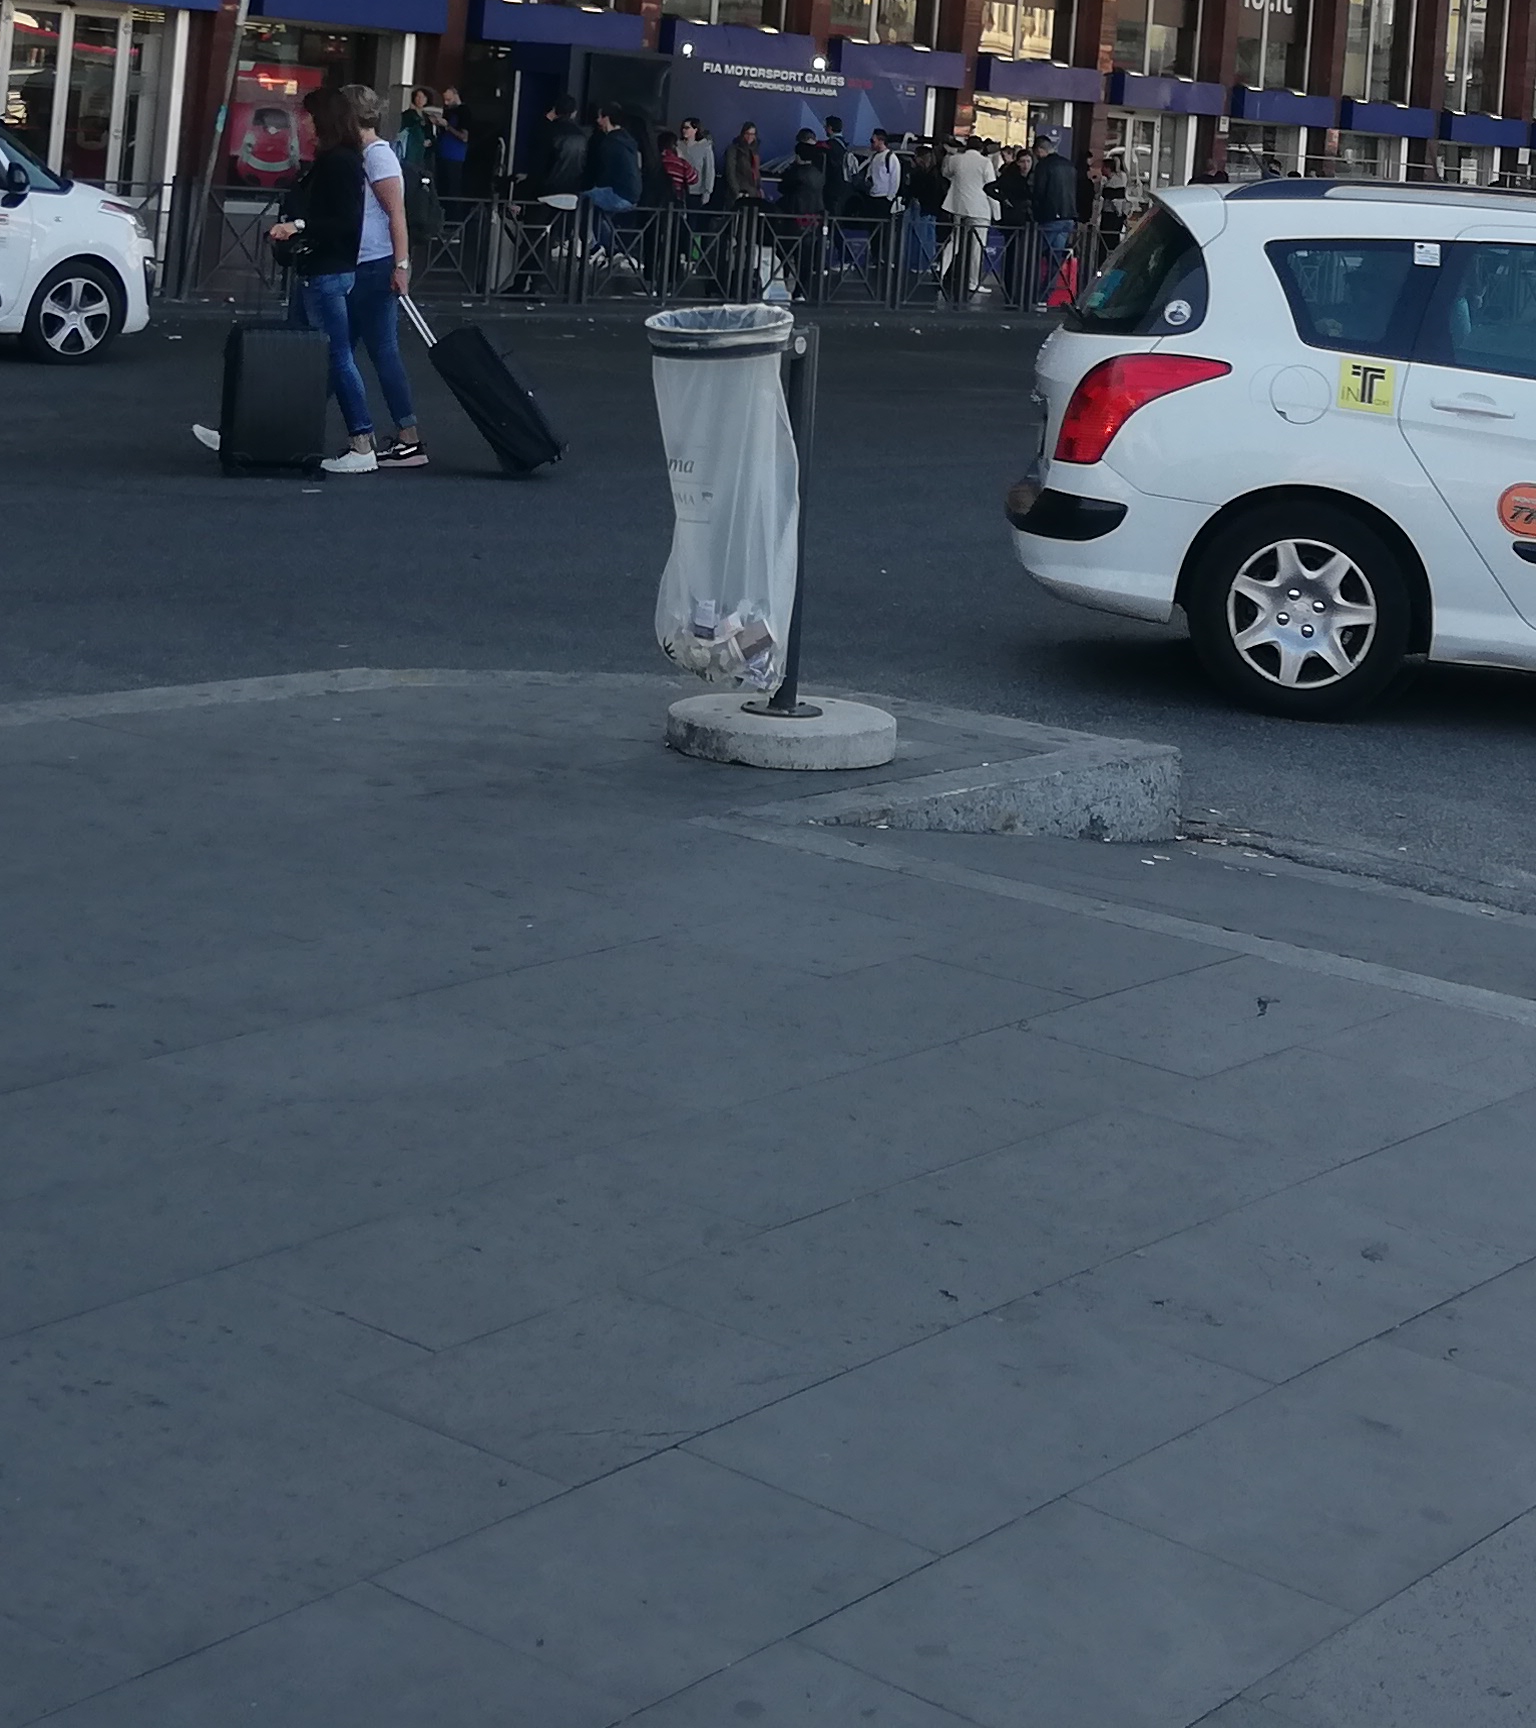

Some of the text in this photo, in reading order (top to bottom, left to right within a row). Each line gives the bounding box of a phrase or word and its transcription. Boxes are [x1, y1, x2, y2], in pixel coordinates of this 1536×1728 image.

[703, 62, 723, 74] FIA
[724, 65, 804, 83] MOTORSPORT
[805, 73, 846, 87] GAMES
